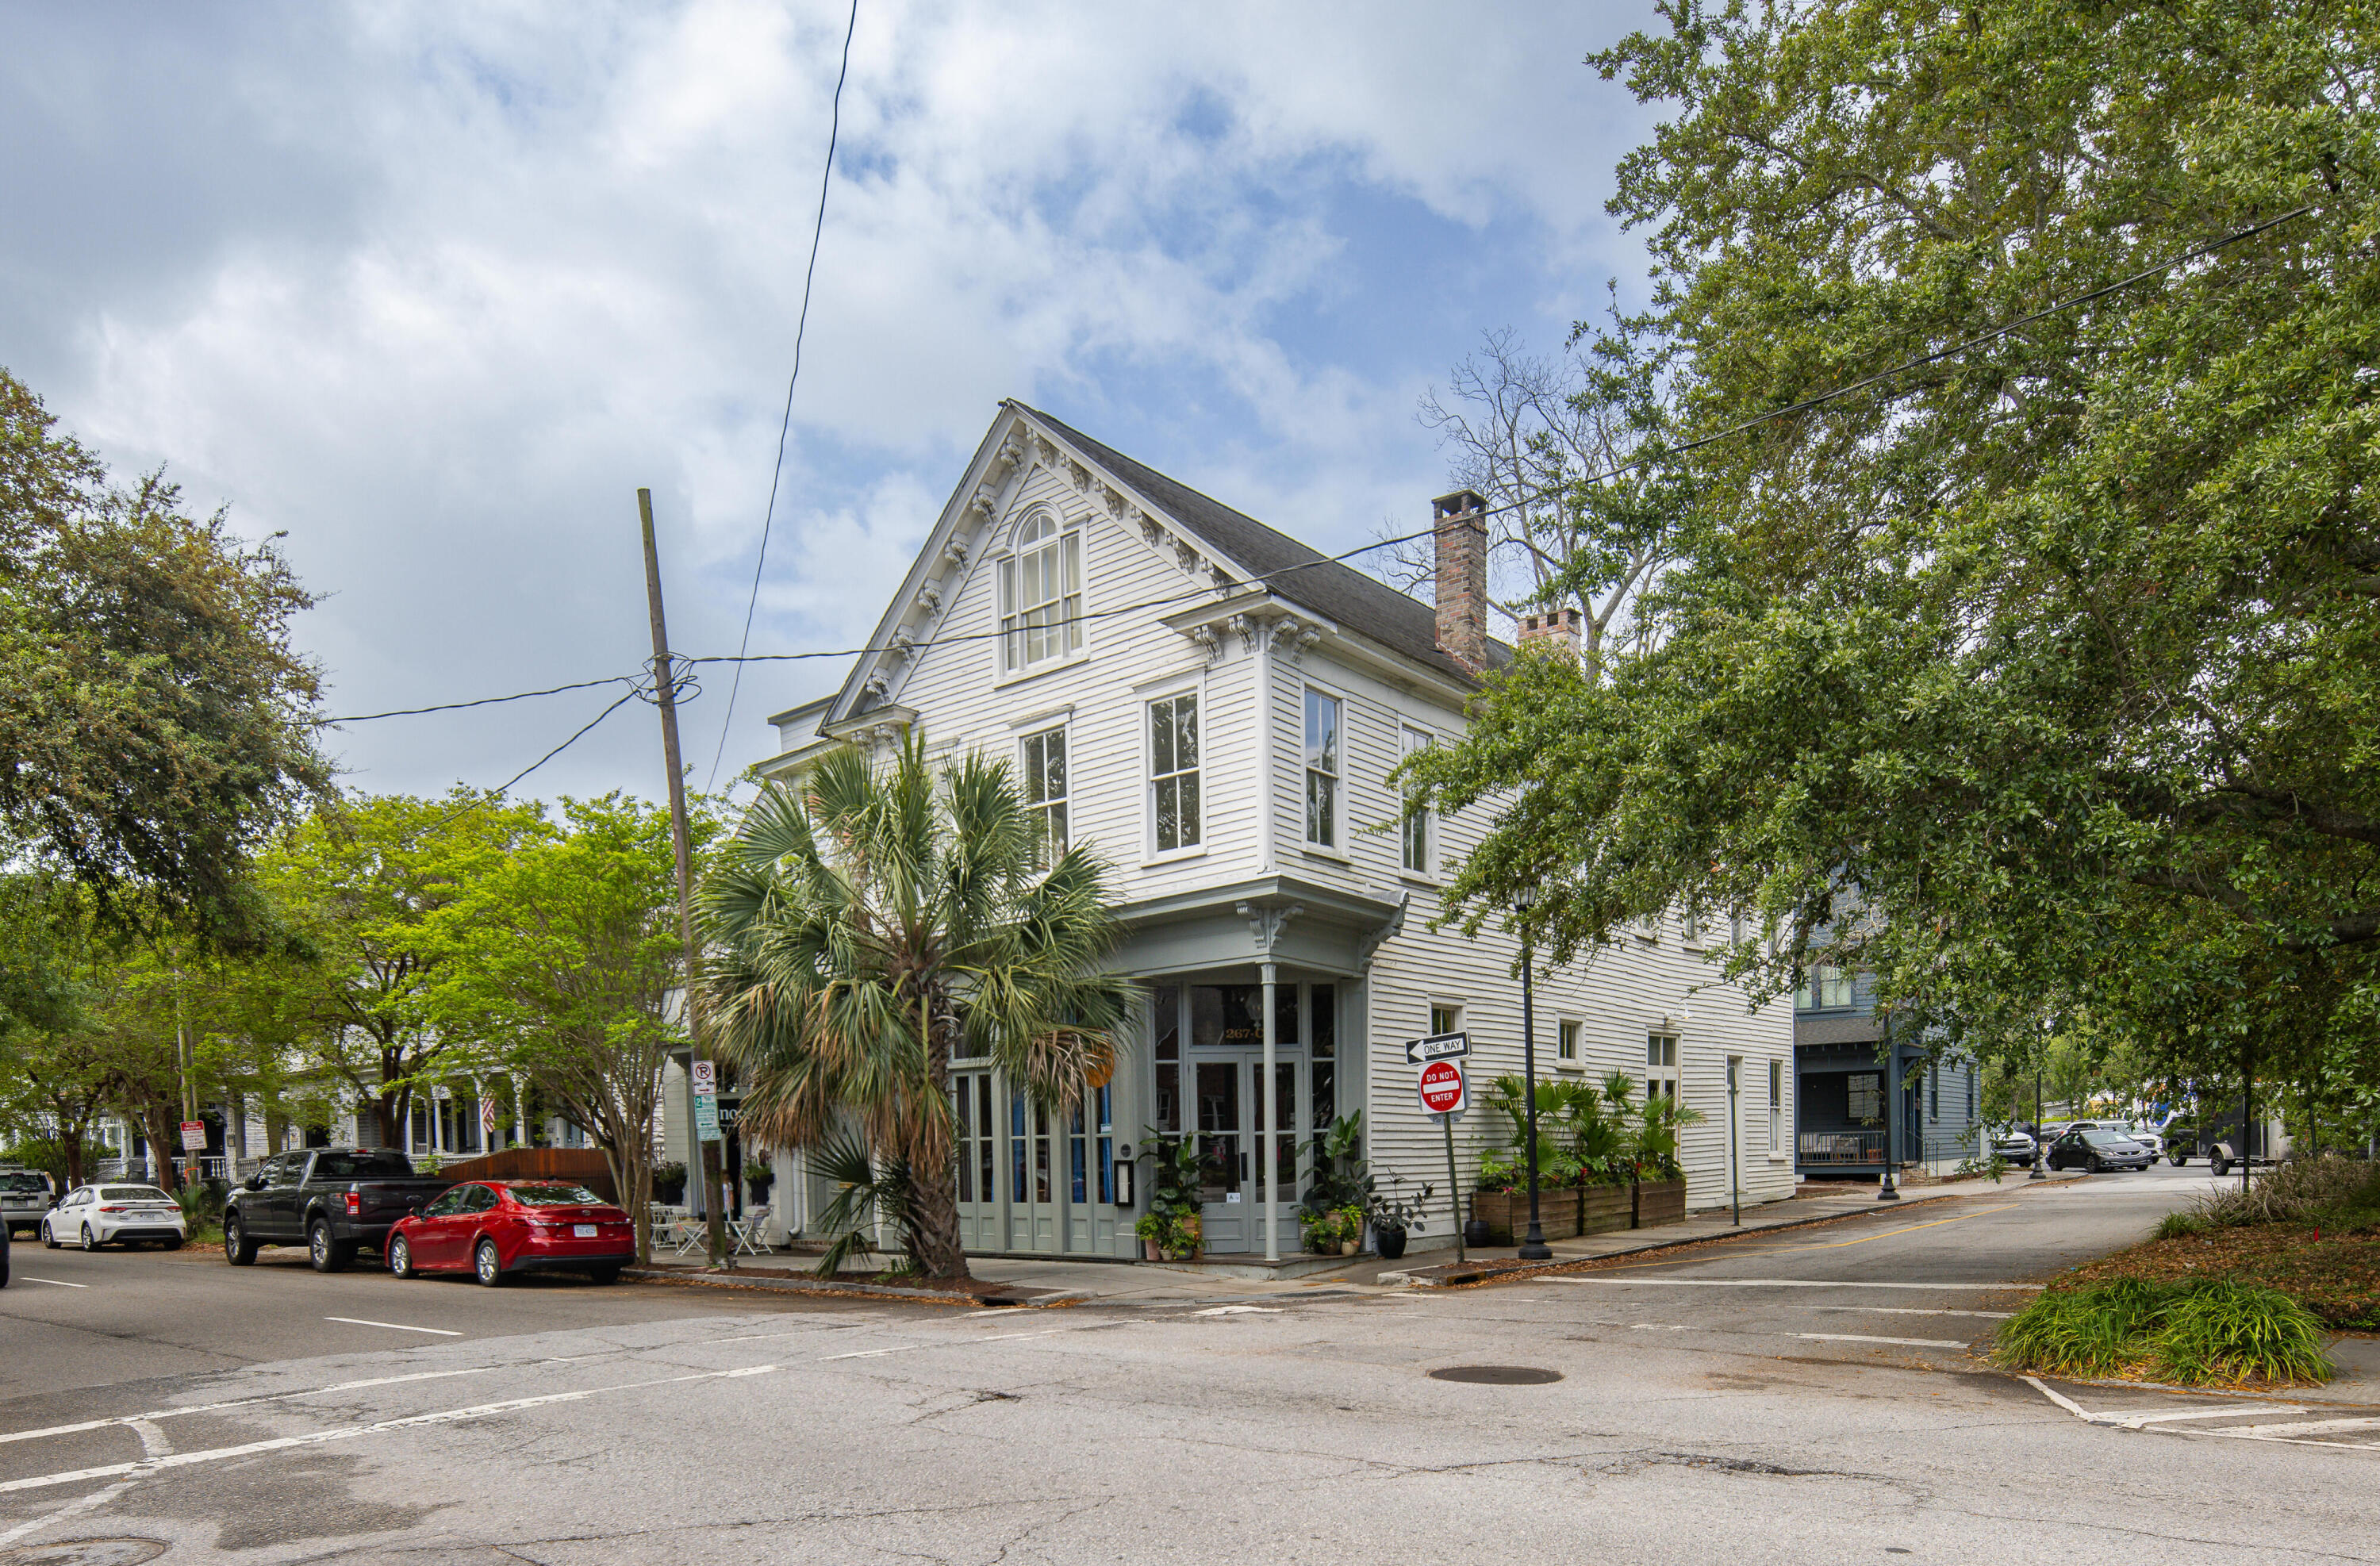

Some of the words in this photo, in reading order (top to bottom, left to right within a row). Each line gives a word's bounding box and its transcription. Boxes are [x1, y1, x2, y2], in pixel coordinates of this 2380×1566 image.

[1424, 1043, 1441, 1054] ONE
[1443, 1040, 1461, 1051] WAY
[1426, 1073, 1437, 1082] DO
[1439, 1070, 1454, 1080] NOT
[1430, 1092, 1453, 1103] ENTER
